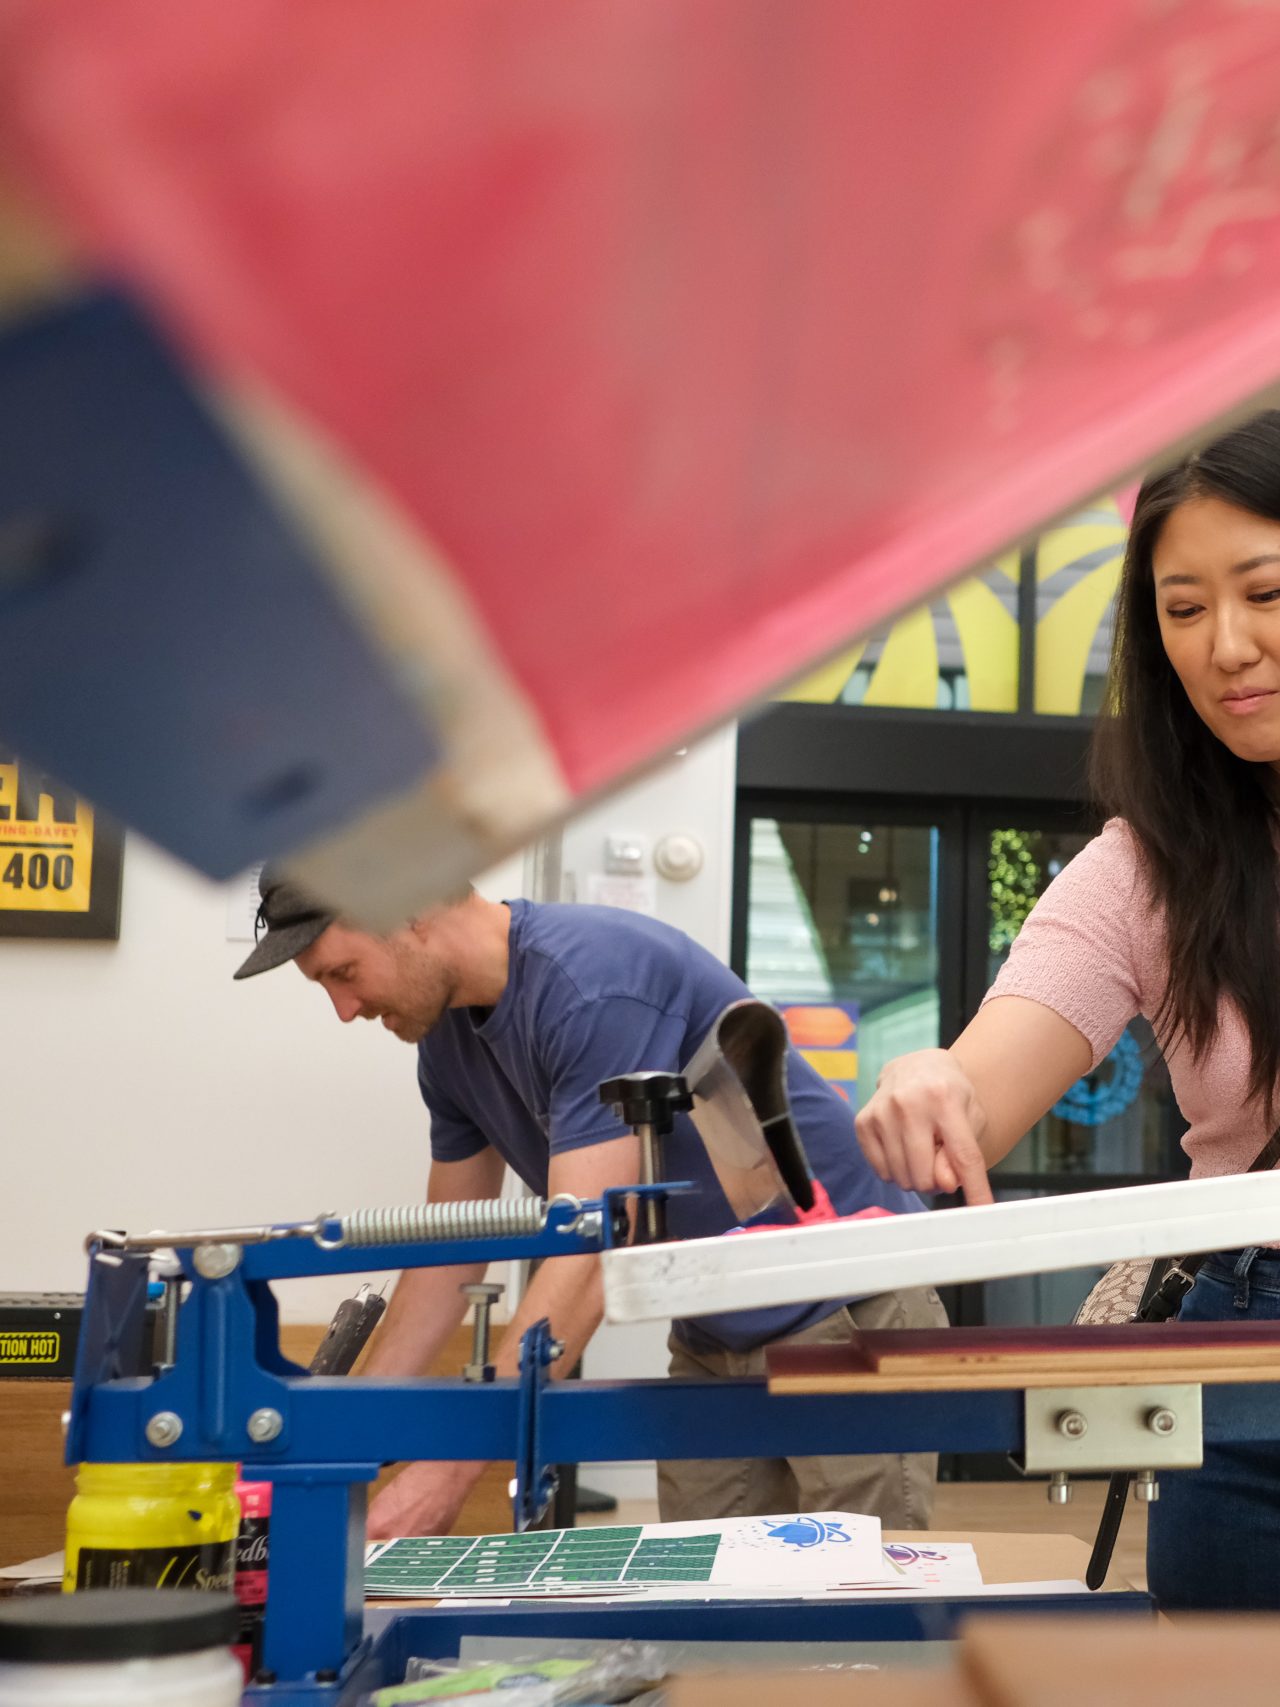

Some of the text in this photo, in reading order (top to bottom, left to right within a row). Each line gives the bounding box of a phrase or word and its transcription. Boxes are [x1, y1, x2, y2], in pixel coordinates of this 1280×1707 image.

[2, 852, 74, 891] 400
[0, 1339, 55, 1356] TION HOT
